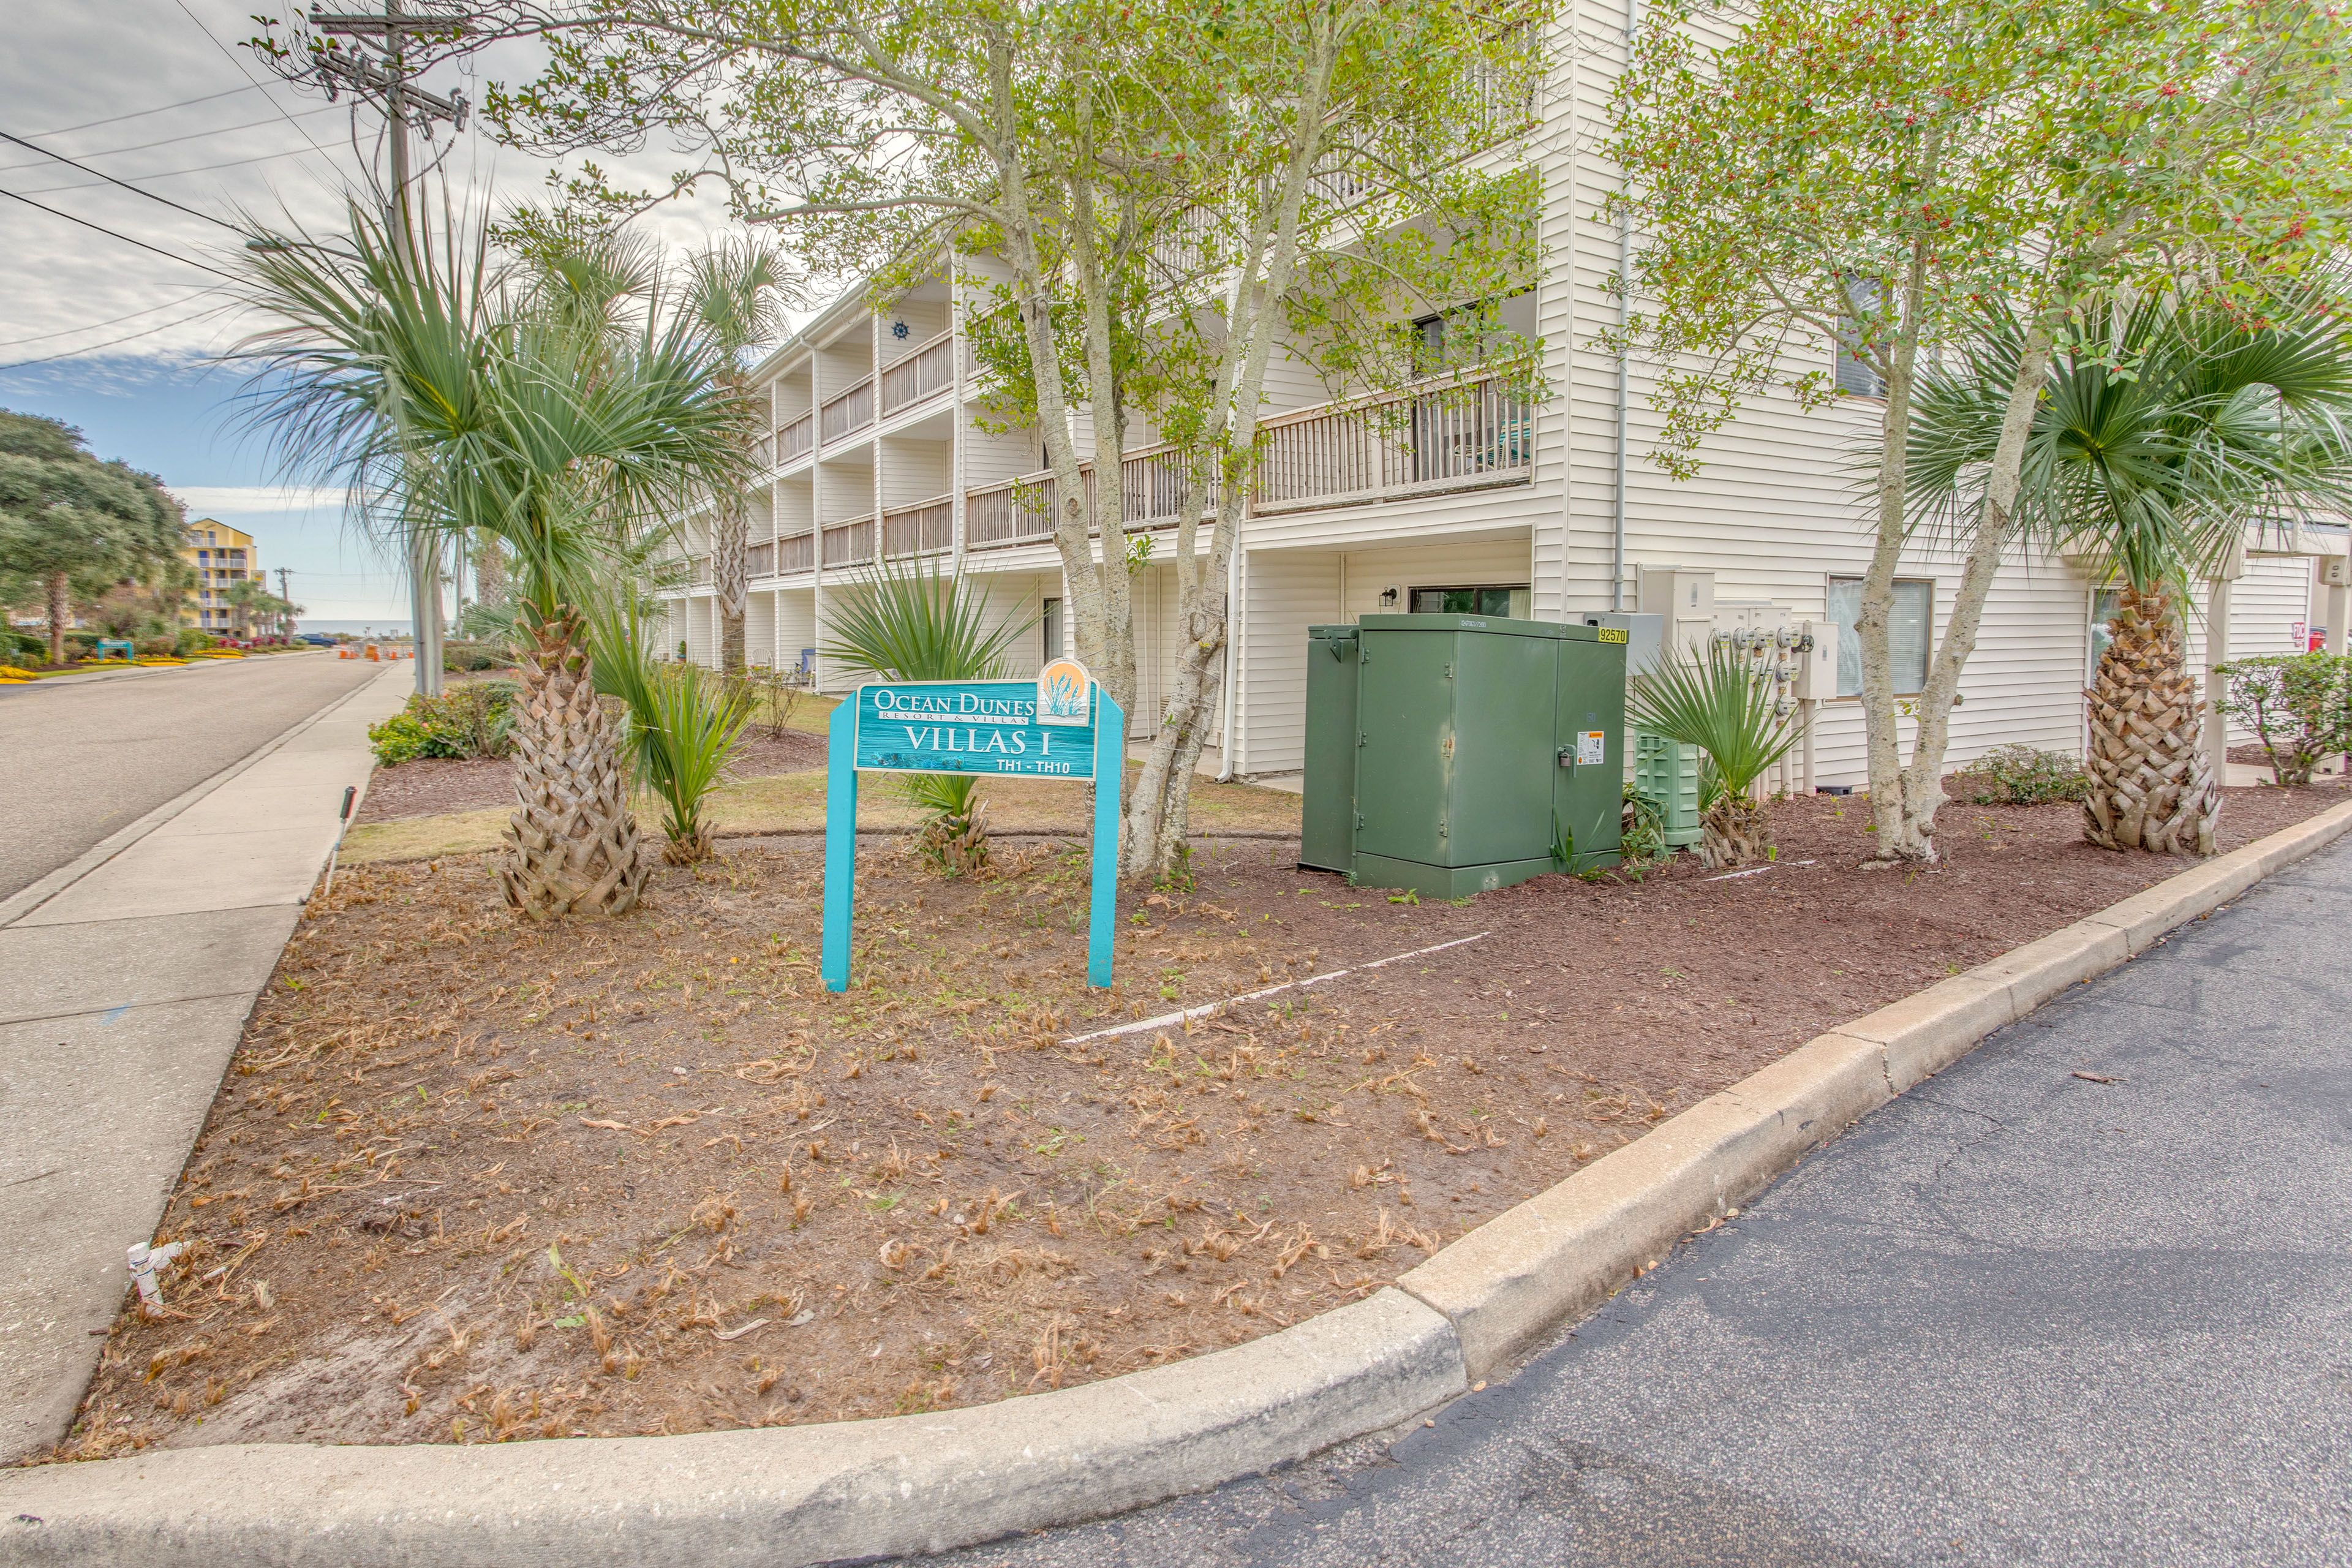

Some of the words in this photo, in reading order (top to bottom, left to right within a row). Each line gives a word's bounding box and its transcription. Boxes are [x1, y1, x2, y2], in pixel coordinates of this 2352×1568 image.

[1600, 628, 1626, 642] 92570
[2294, 624, 2305, 638] FDC
[874, 690, 951, 713] OCEAN
[959, 693, 1035, 716] DUNES
[883, 712, 946, 721] RESORT
[973, 715, 1026, 724] VILLAS
[903, 726, 1026, 755] VILLAS
[1040, 732, 1051, 756] I
[996, 759, 1021, 772] TH1
[1035, 760, 1070, 774] TH10
